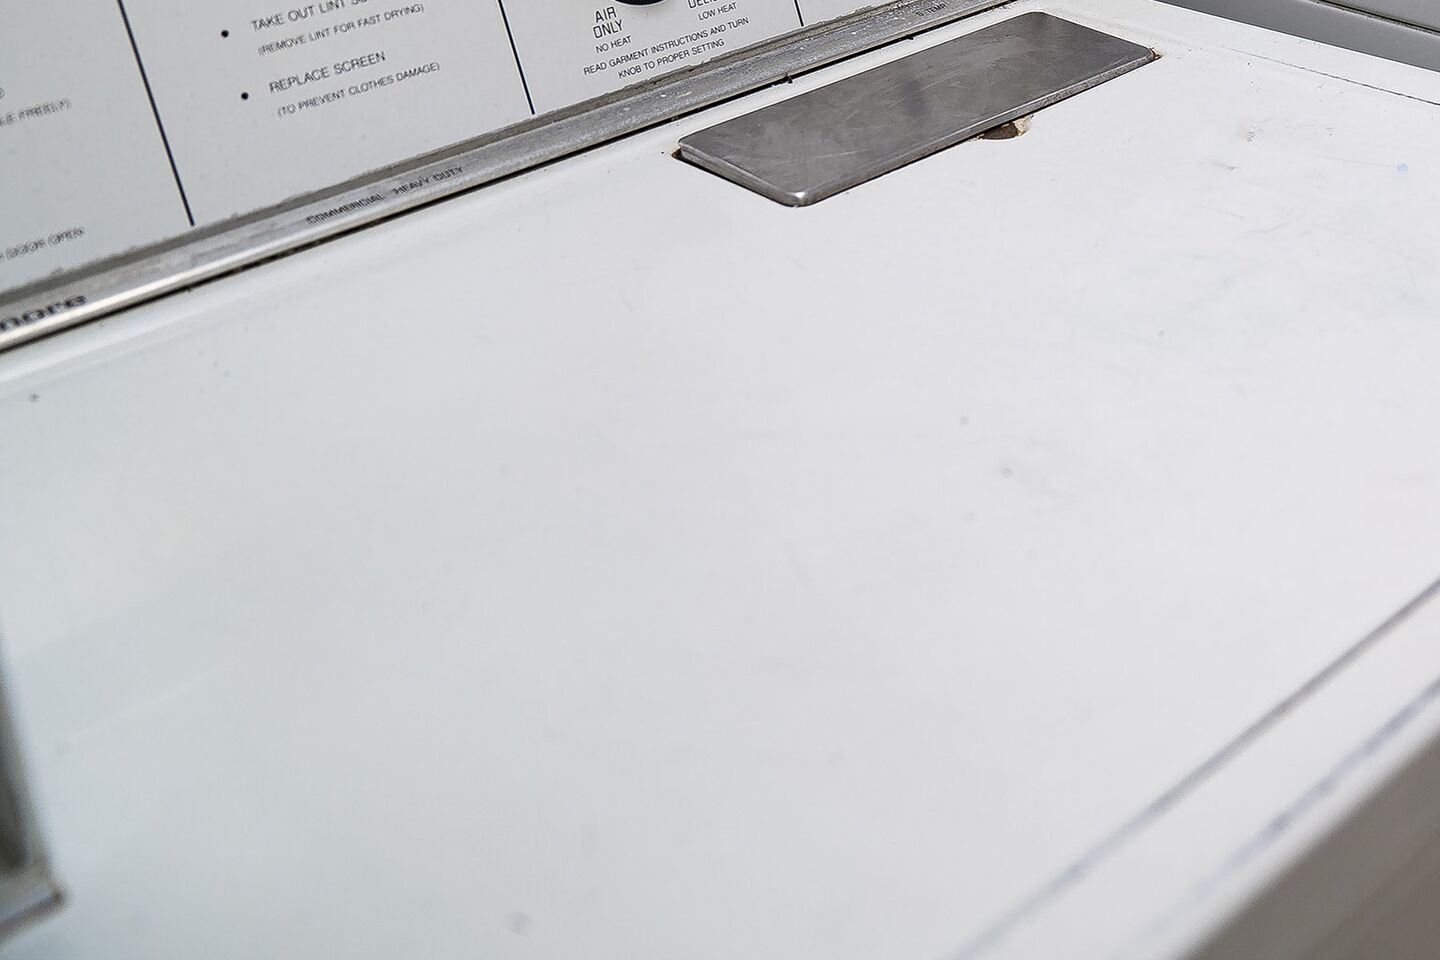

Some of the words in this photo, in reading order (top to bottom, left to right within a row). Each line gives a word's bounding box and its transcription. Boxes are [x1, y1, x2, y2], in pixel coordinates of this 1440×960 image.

[252, 13, 285, 31] TAKE
[287, 6, 314, 22] OUT
[257, 35, 306, 56] (REMOVE
[308, 28, 331, 41] LINT
[333, 22, 356, 34] FOR
[357, 14, 381, 28] FAST
[384, 3, 425, 22] DRYING)
[592, 19, 624, 39] ONLY
[595, 6, 617, 24] AIR
[698, 10, 716, 21] LOW
[717, 2, 737, 15] HEAT
[583, 63, 607, 76] READ
[608, 48, 649, 68] GARMENT
[650, 30, 709, 54] INSTRUCTIONS
[710, 24, 726, 35] AND
[727, 17, 749, 29] TURN
[595, 43, 609, 54] NO
[611, 36, 632, 48] HEAT
[618, 65, 642, 79] KNOB
[643, 60, 655, 70] TO
[657, 49, 690, 66] PROPER
[691, 38, 725, 55] SETTING
[269, 67, 330, 93] REPLACE
[333, 51, 386, 75] SCREEN
[278, 104, 296, 119] (TO
[299, 89, 345, 110] PREVENT
[348, 76, 394, 97] CLOTHES
[396, 62, 440, 82] DAMAGE)
[306, 193, 385, 225] COMMERCIAL
[392, 177, 430, 196] HEAVY
[433, 166, 464, 181] DUTY
